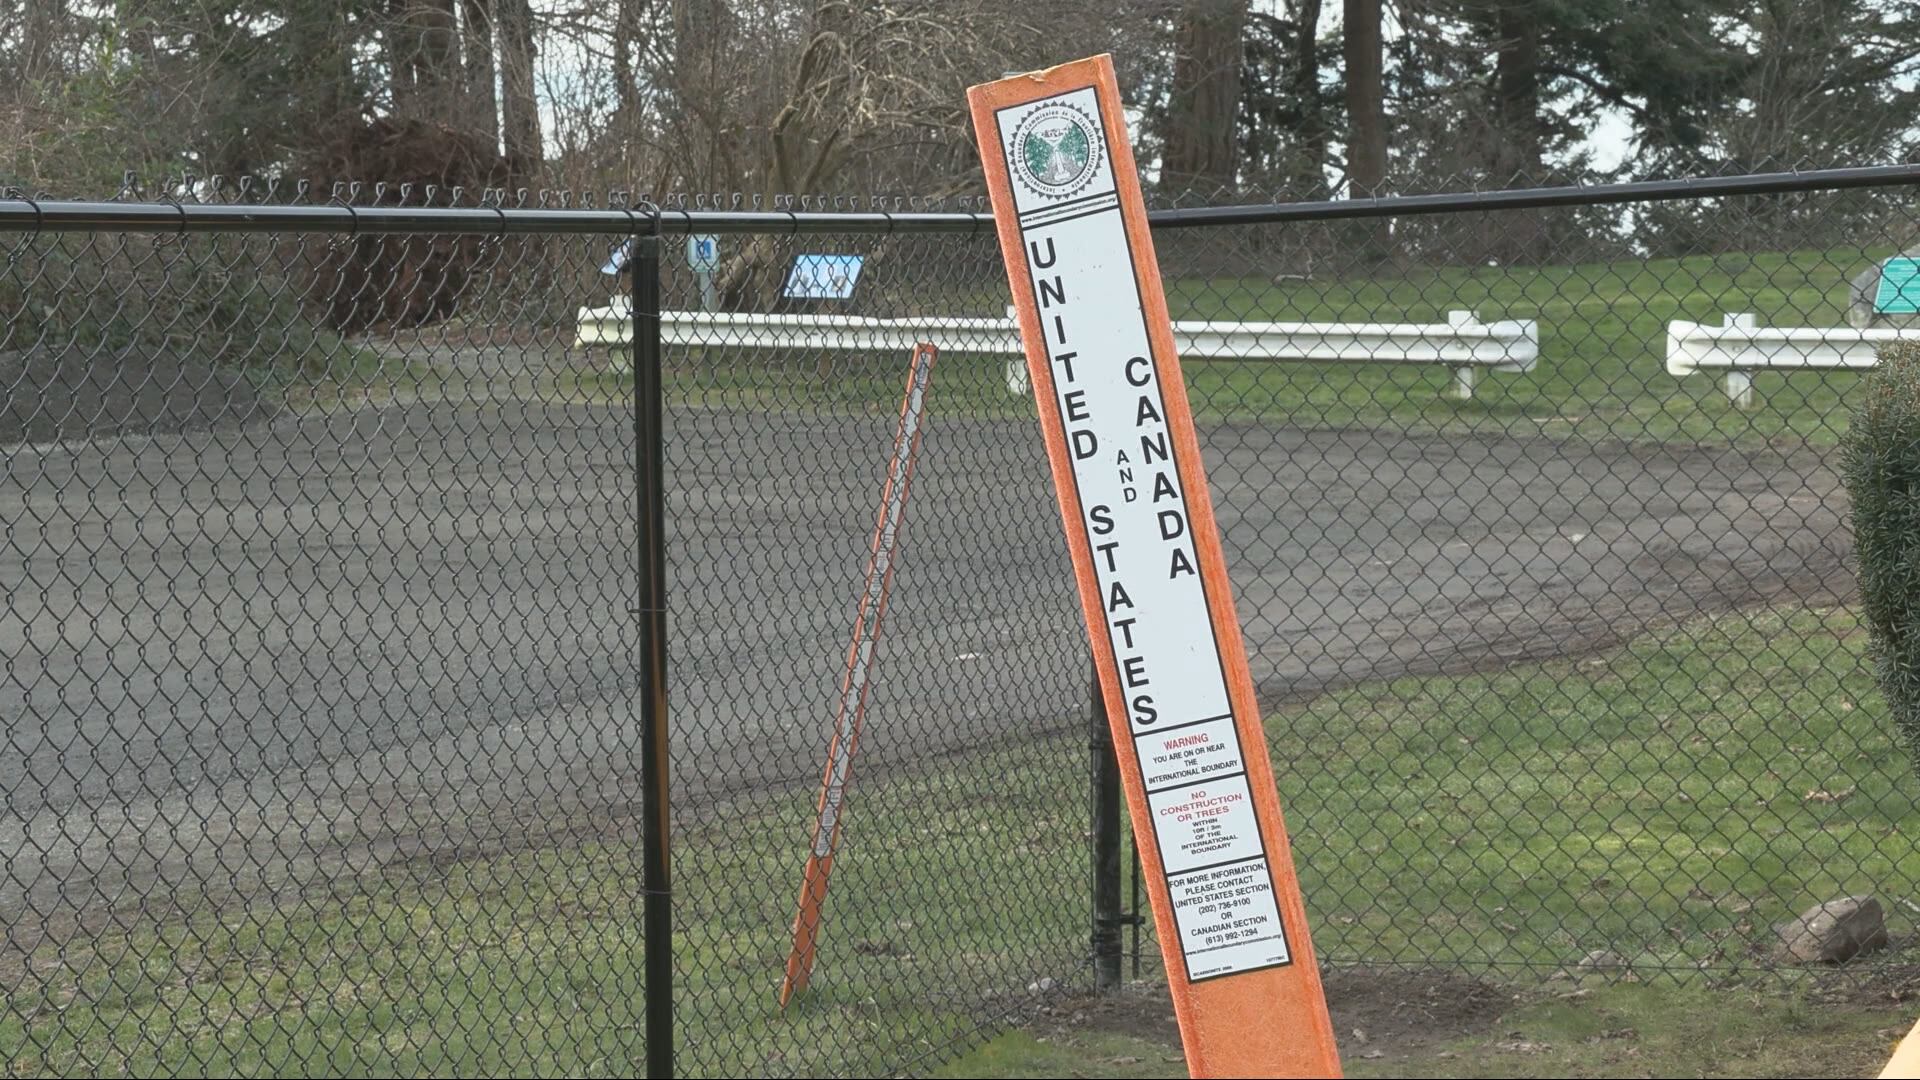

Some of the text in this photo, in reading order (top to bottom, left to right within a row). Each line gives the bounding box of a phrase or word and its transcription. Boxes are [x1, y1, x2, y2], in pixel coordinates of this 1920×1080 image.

[1116, 449, 1137, 503] AND
[1125, 357, 1195, 580] CANADA
[1030, 237, 1098, 460] UNITED
[1089, 504, 1158, 725] STATES
[1163, 733, 1209, 751] WARNING
[1153, 743, 1225, 764] YOU ARE ON OR NEAR
[1149, 760, 1238, 784] INTERNATIONAL BOUNDARY
[1184, 759, 1198, 767] THE
[1191, 790, 1206, 800] NO
[1160, 793, 1242, 816] CONSTRUCTION
[1177, 806, 1230, 822] OR TREES
[1192, 818, 1218, 827] WITHIN
[1181, 834, 1238, 850] INTERNATIONAL
[1191, 842, 1232, 855] BOUNDARY
[1169, 878, 1185, 889] FOR
[1187, 874, 1209, 885] MORE
[1185, 875, 1253, 895] PLEASE CONTACT
[1175, 883, 1269, 908] UNITED STATES SECTION
[1198, 897, 1251, 915] (202) 736-9100
[1220, 911, 1233, 920] OR
[1191, 915, 1268, 937] CANADIAN SECTION
[1205, 927, 1258, 945] (613) 992-1294
